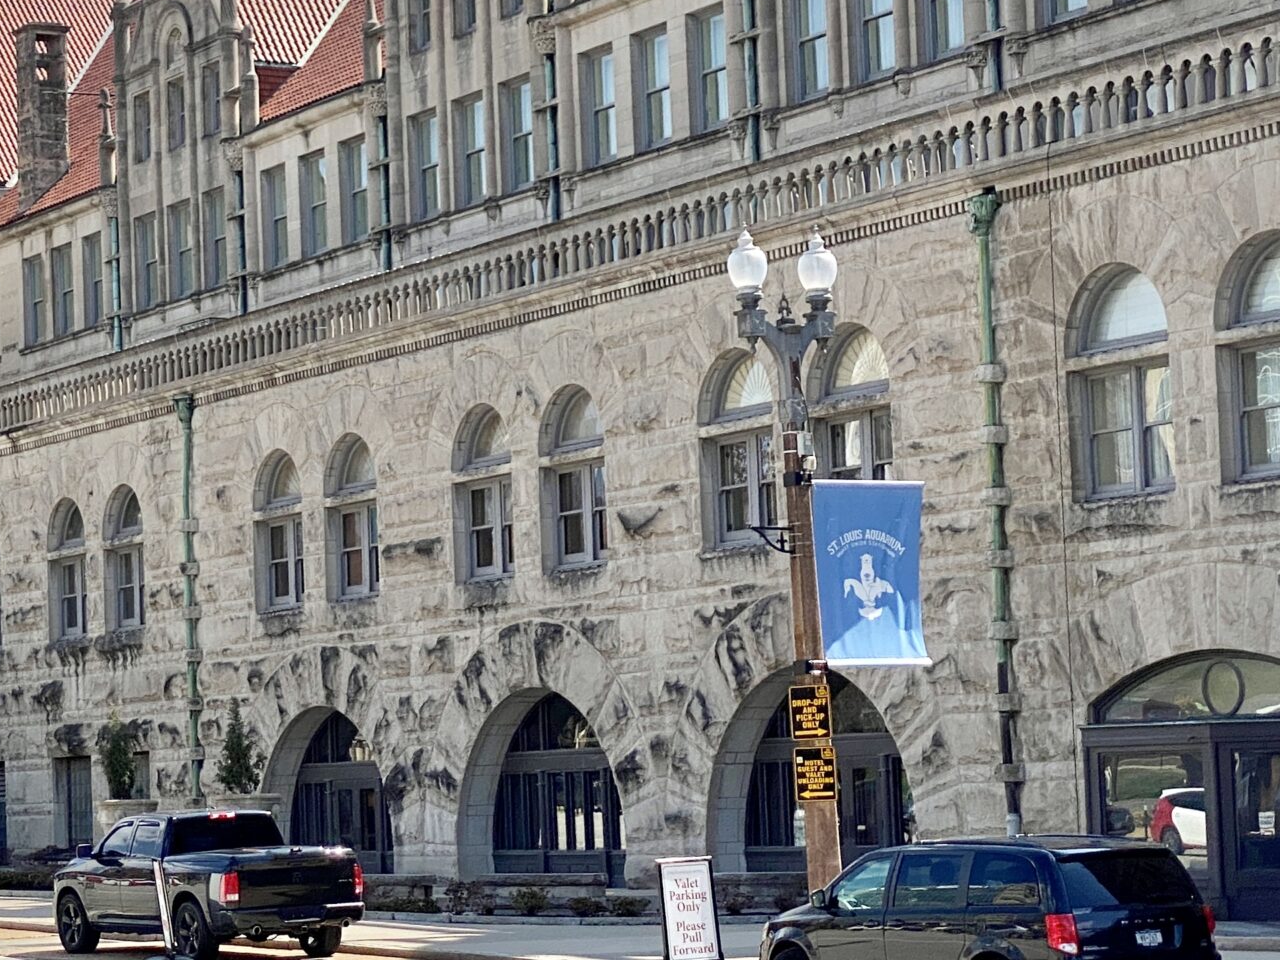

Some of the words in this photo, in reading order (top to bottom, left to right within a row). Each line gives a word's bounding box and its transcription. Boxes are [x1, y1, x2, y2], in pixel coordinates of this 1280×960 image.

[840, 529, 862, 546] LOUIS
[865, 528, 906, 556] AQUARIUM
[792, 699, 826, 707] DROP-OFF
[796, 713, 825, 721] PICK-UP
[674, 878, 699, 889] Valet
[669, 890, 707, 902] Parking
[677, 901, 701, 914] Only
[676, 921, 706, 932] Please
[682, 931, 702, 943] Pull
[673, 943, 715, 956] Forward
